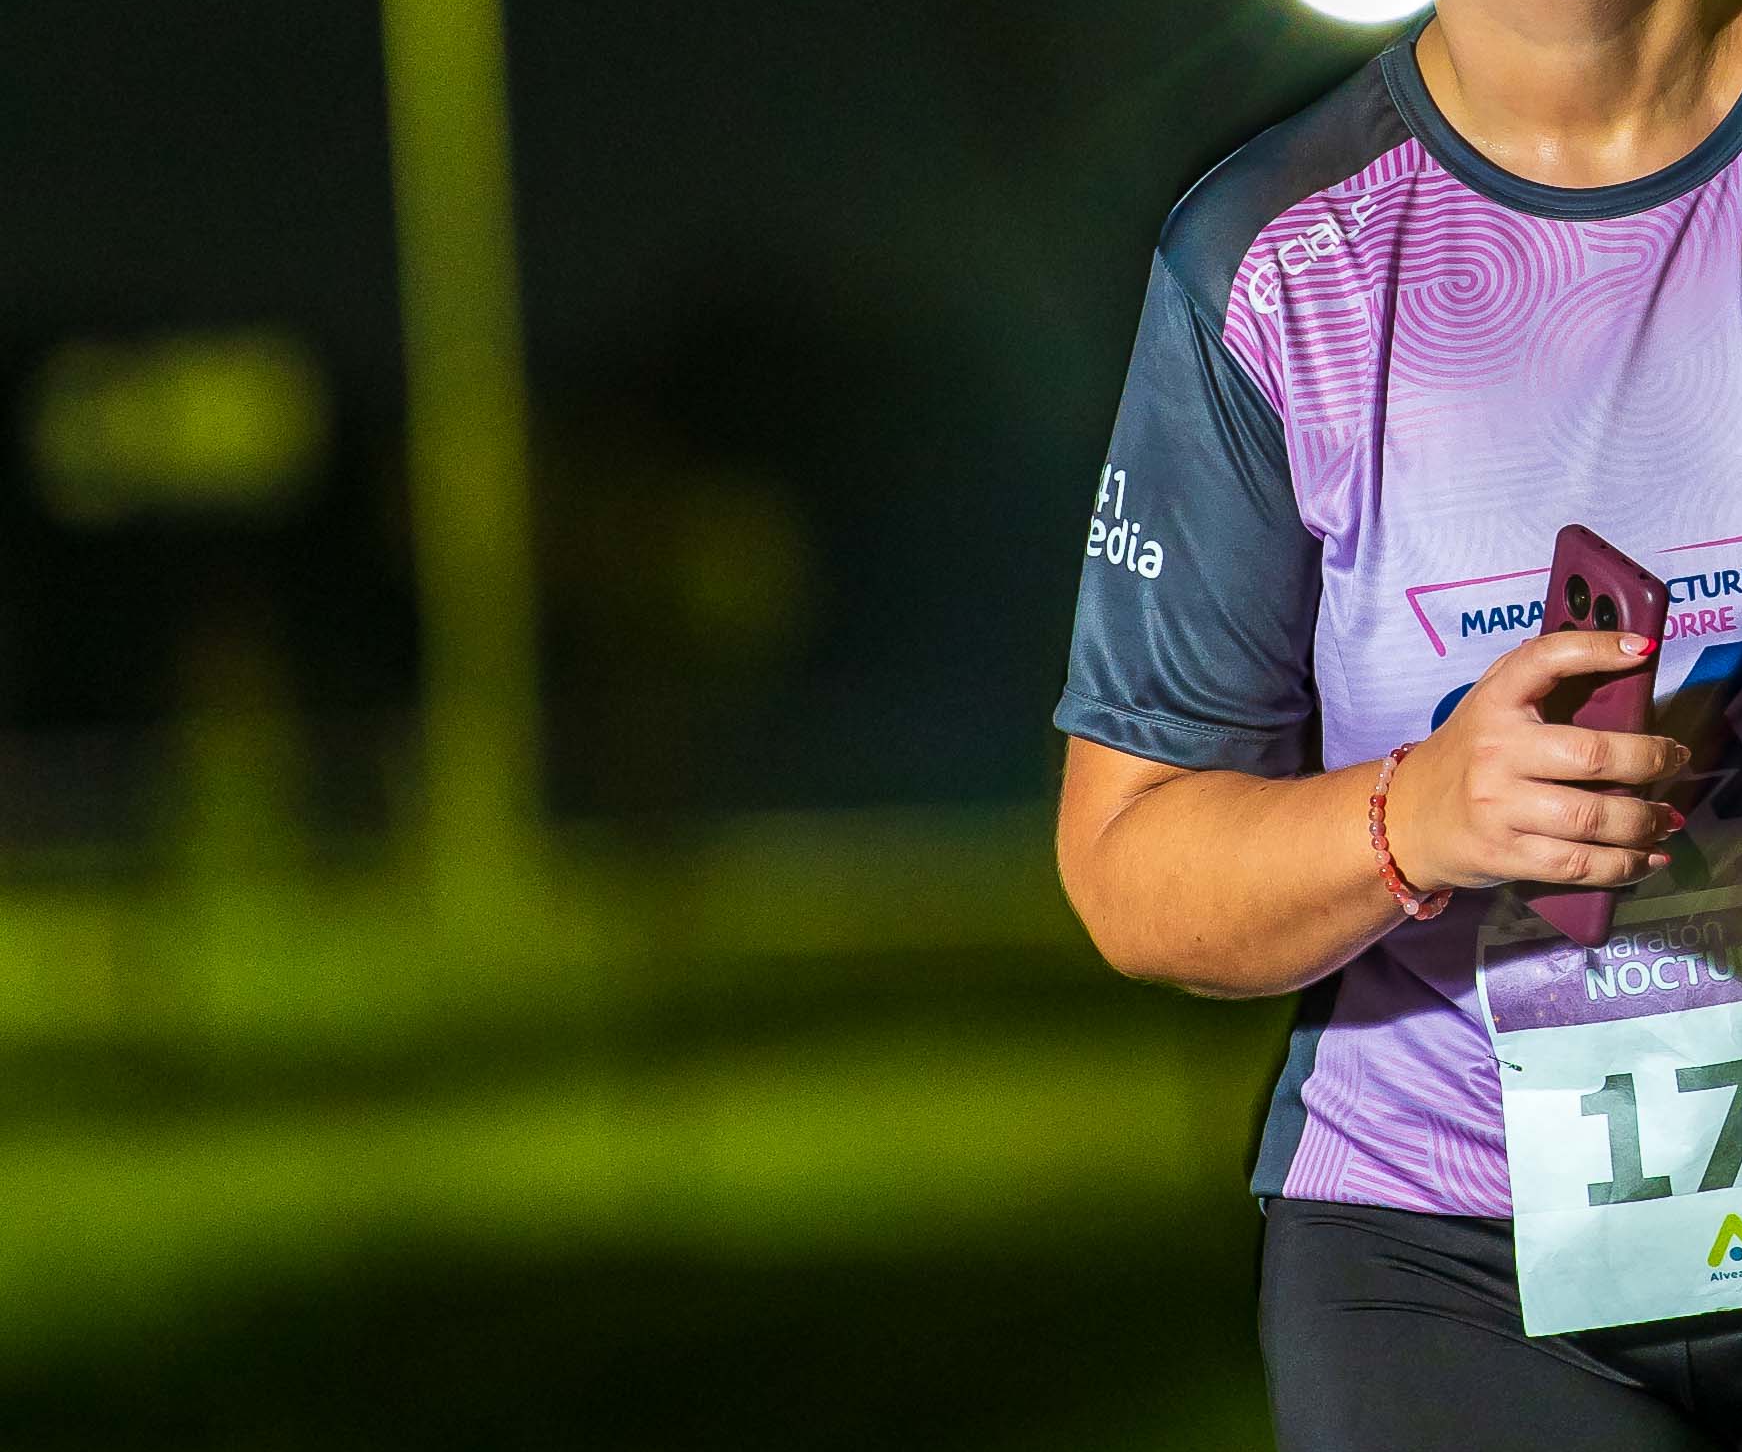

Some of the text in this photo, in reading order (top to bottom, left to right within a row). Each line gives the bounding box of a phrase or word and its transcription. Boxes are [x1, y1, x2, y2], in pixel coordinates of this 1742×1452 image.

[1086, 515, 1164, 580] edia
[1461, 600, 1547, 638] MARA
[1662, 605, 1738, 641] ORRE
